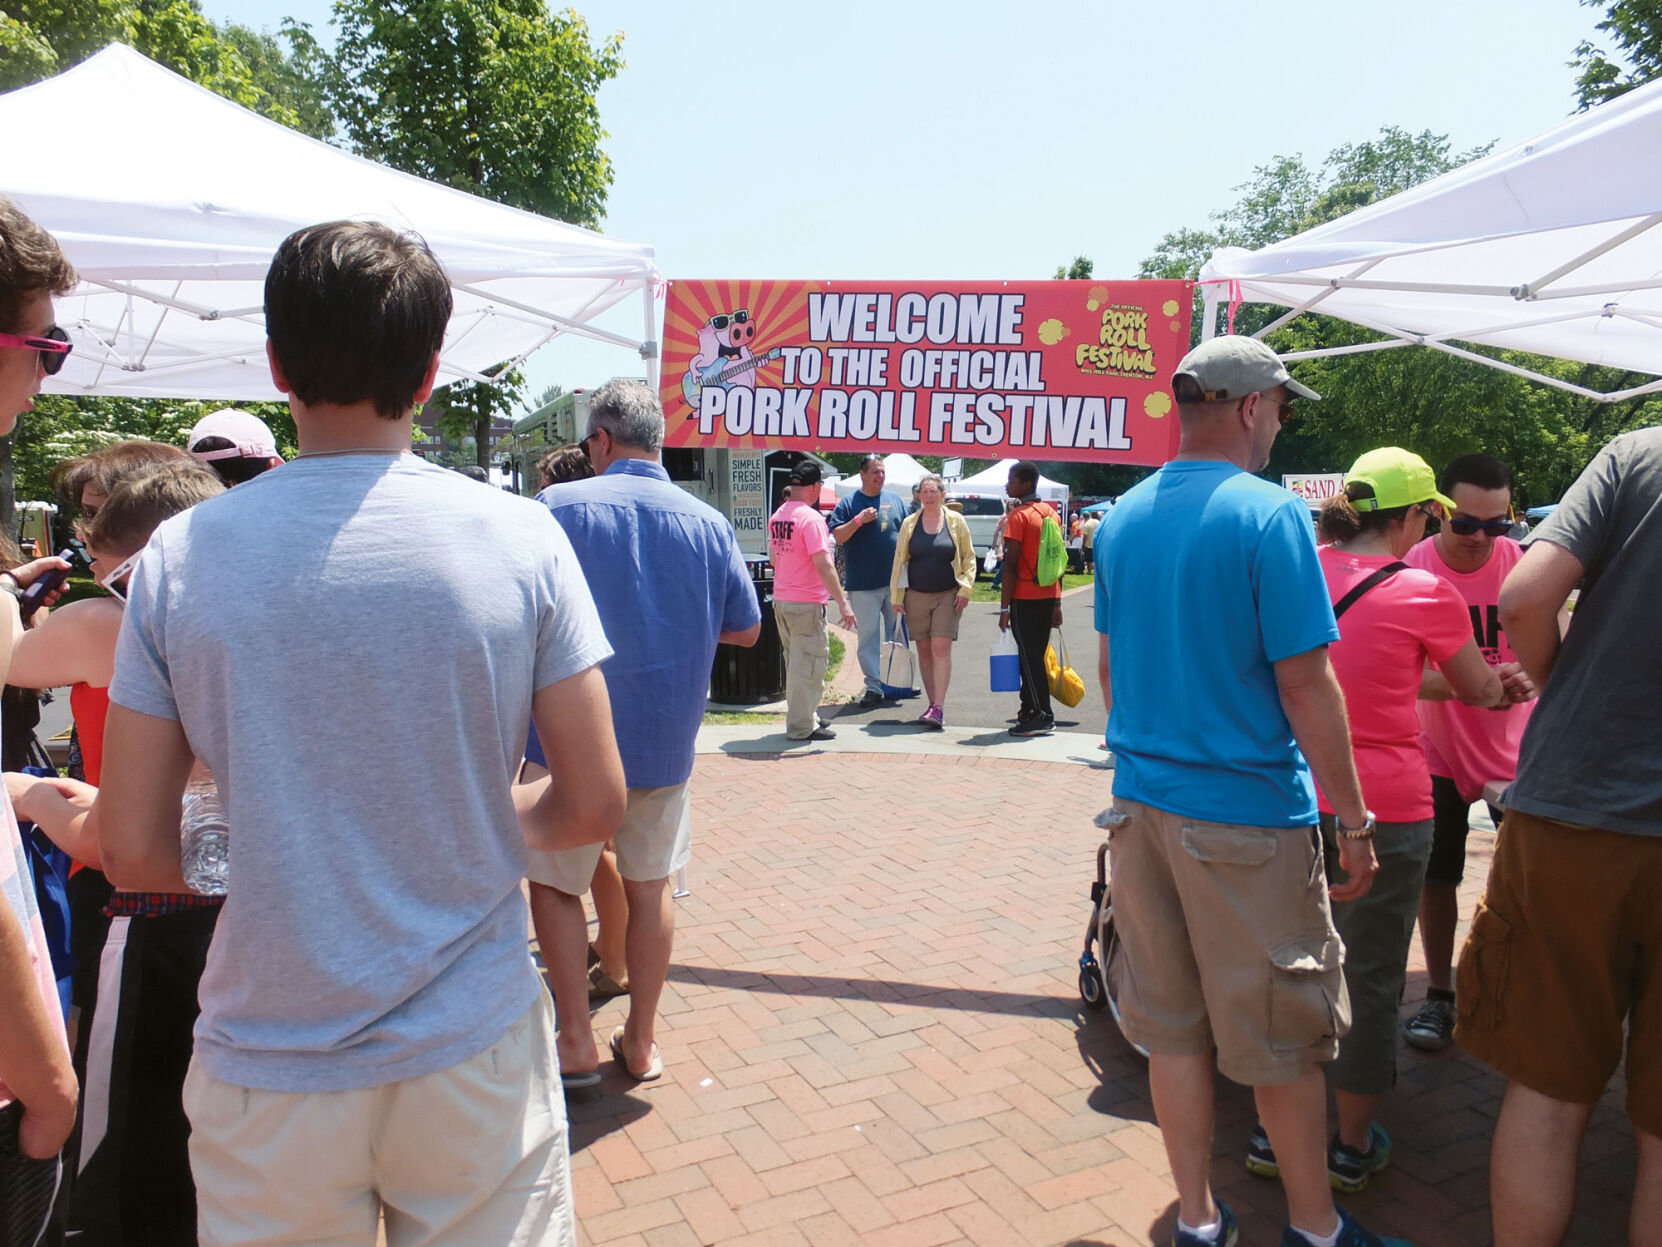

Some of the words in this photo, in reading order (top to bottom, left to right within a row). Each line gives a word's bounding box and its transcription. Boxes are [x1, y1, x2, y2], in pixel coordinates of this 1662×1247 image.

[809, 292, 1025, 345] WELCOME
[1102, 309, 1148, 329] PORK
[1100, 324, 1152, 351] ROLL
[780, 345, 823, 386] TO
[827, 347, 889, 387] THE
[899, 348, 1046, 392] OFFICIAL
[1076, 343, 1157, 374] FESTIVAL
[699, 384, 814, 436] PORK
[817, 388, 921, 442] ROLL
[928, 391, 1132, 450] FESTIVAL
[732, 459, 761, 470] SIMPLE
[732, 470, 762, 482] FRESH
[733, 483, 762, 493] FLAVORS
[1304, 479, 1336, 499] SAND
[733, 507, 762, 517] FRESHLY
[734, 517, 763, 530] MADE
